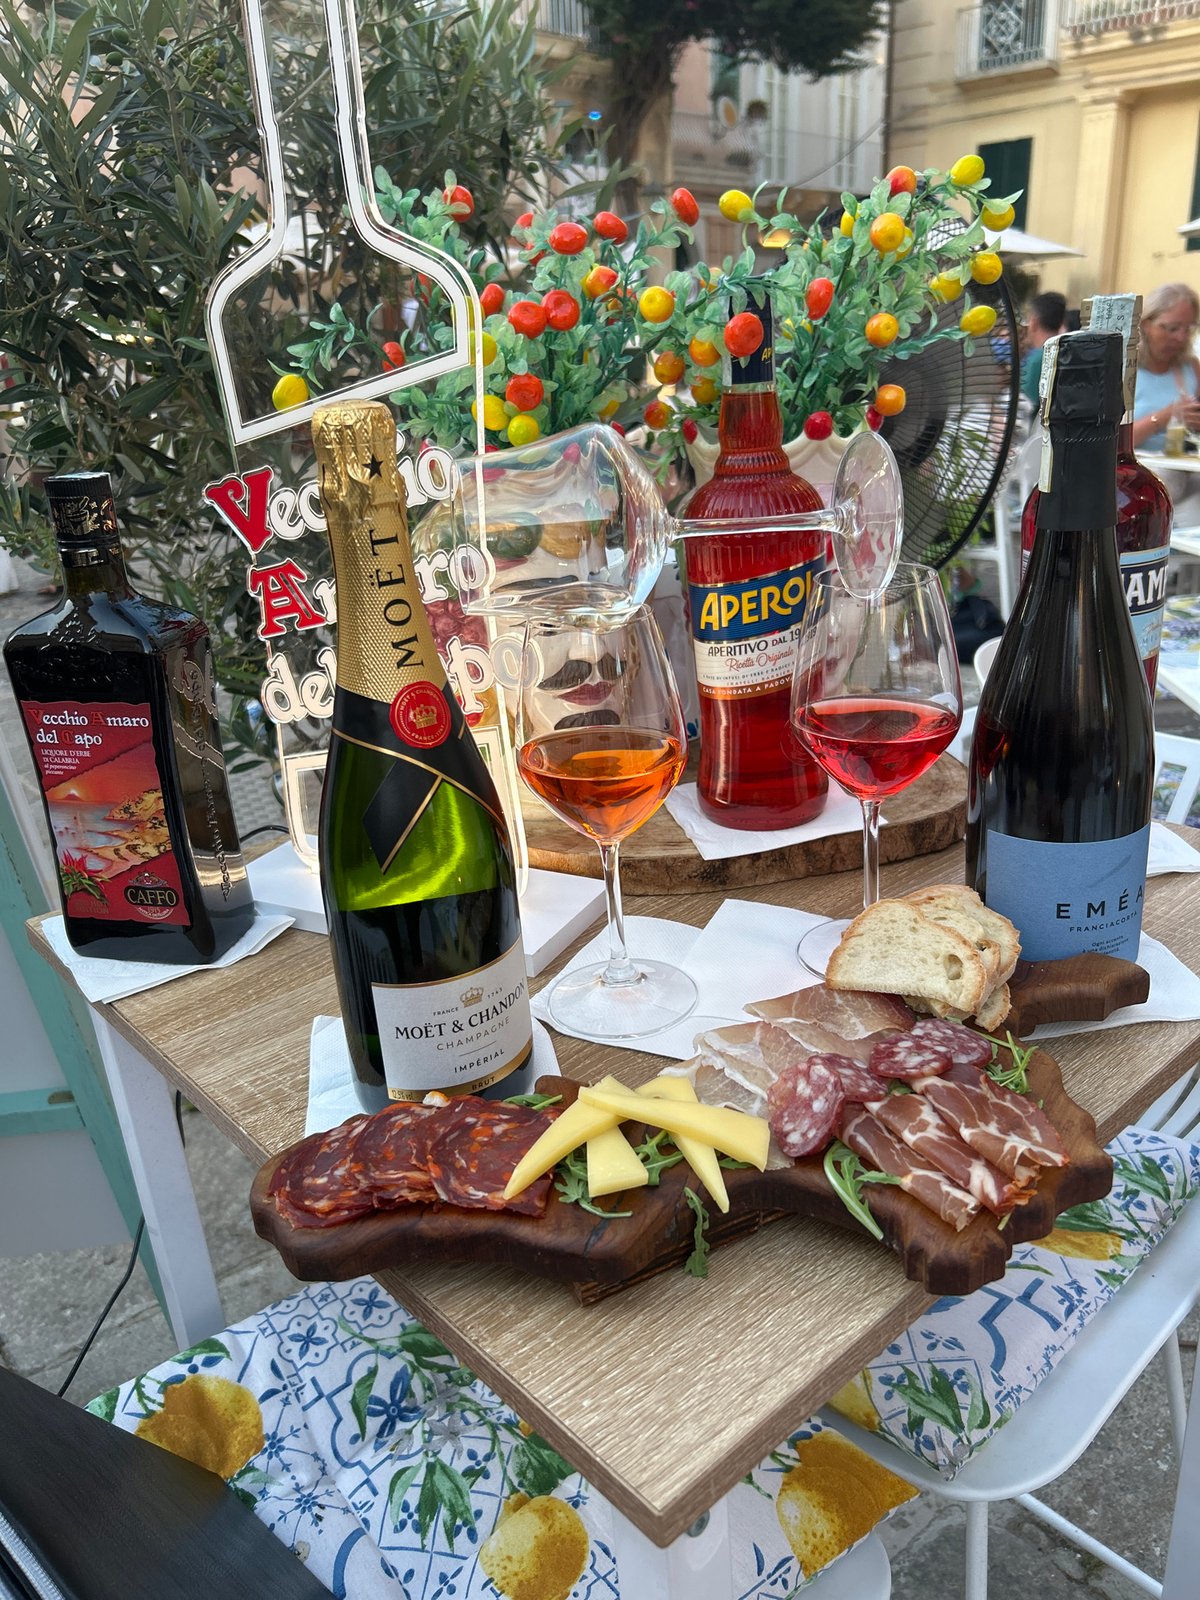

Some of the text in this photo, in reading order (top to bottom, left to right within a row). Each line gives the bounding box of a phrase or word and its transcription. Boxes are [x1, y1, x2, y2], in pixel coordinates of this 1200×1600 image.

[204, 436, 459, 551] Vecio
[250, 544, 489, 637] Aro
[369, 528, 424, 669] MOËT
[708, 640, 768, 657] APERITIVO
[772, 636, 788, 647] DAL
[725, 657, 755, 672] Ricetta
[756, 646, 794, 667] Originale
[28, 709, 149, 727] Vecchio Amaro
[36, 728, 102, 748] del Capo
[41, 748, 67, 757] LIQUORE
[127, 888, 176, 906] CAFFO
[1069, 911, 1137, 933] FRANCIACORTA
[395, 978, 526, 1040] MOËT & CHANDON
[432, 1006, 459, 1016] FRANCE
[436, 1016, 510, 1051] CHAMPAGNE
[454, 1049, 505, 1073] IMPÉRIAL
[471, 1076, 496, 1091] BRUT
